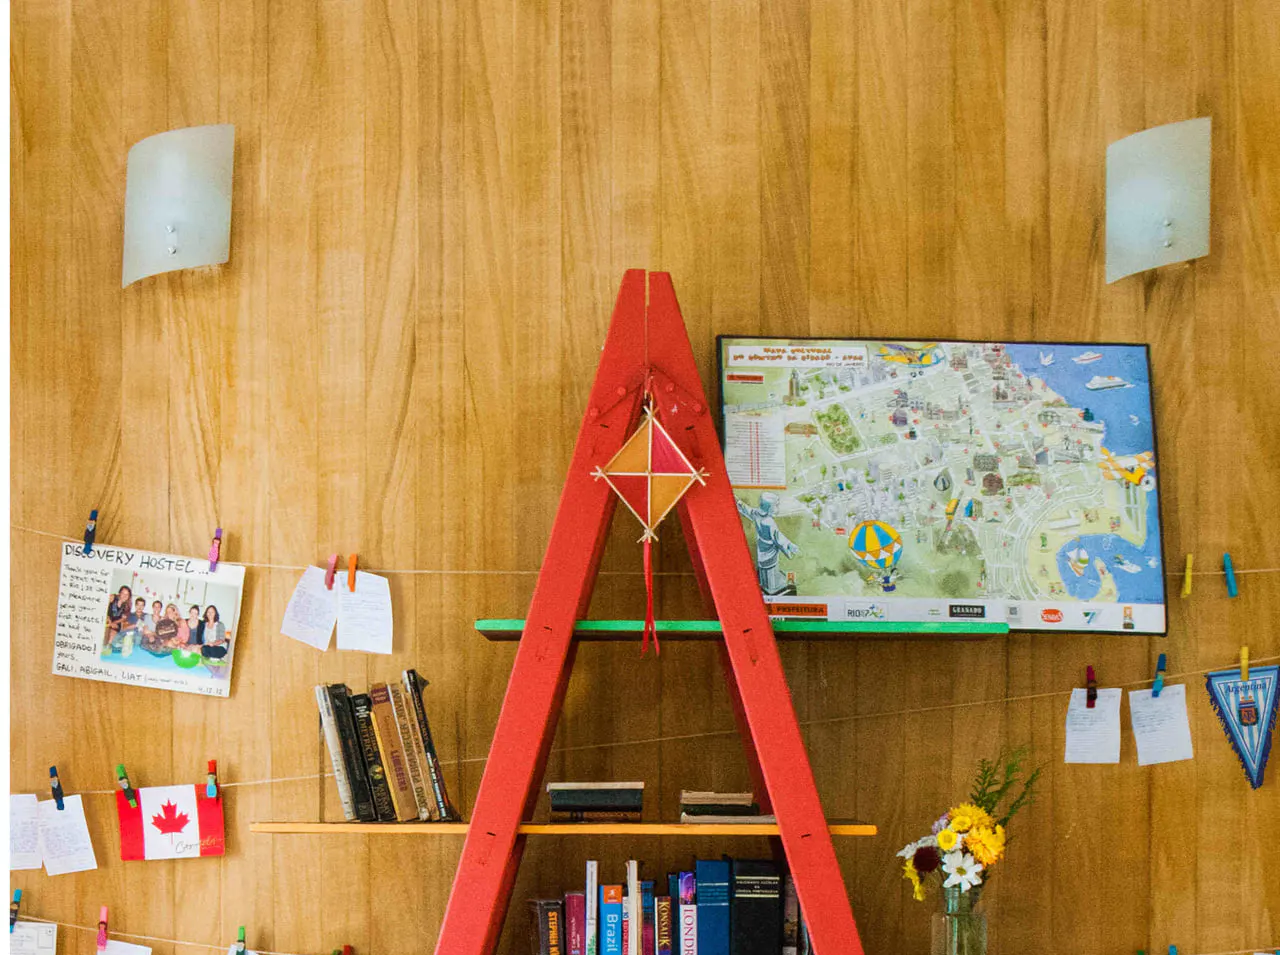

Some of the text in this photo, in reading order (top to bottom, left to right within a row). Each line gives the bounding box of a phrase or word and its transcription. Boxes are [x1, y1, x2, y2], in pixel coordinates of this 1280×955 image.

[65, 544, 134, 566] DISOVERY
[140, 556, 194, 574] HOSTEL
[1224, 682, 1267, 694] Argentina
[548, 911, 559, 945] STEPHEN
[607, 913, 618, 952] Brazil
[659, 901, 671, 946] KONSALIK
